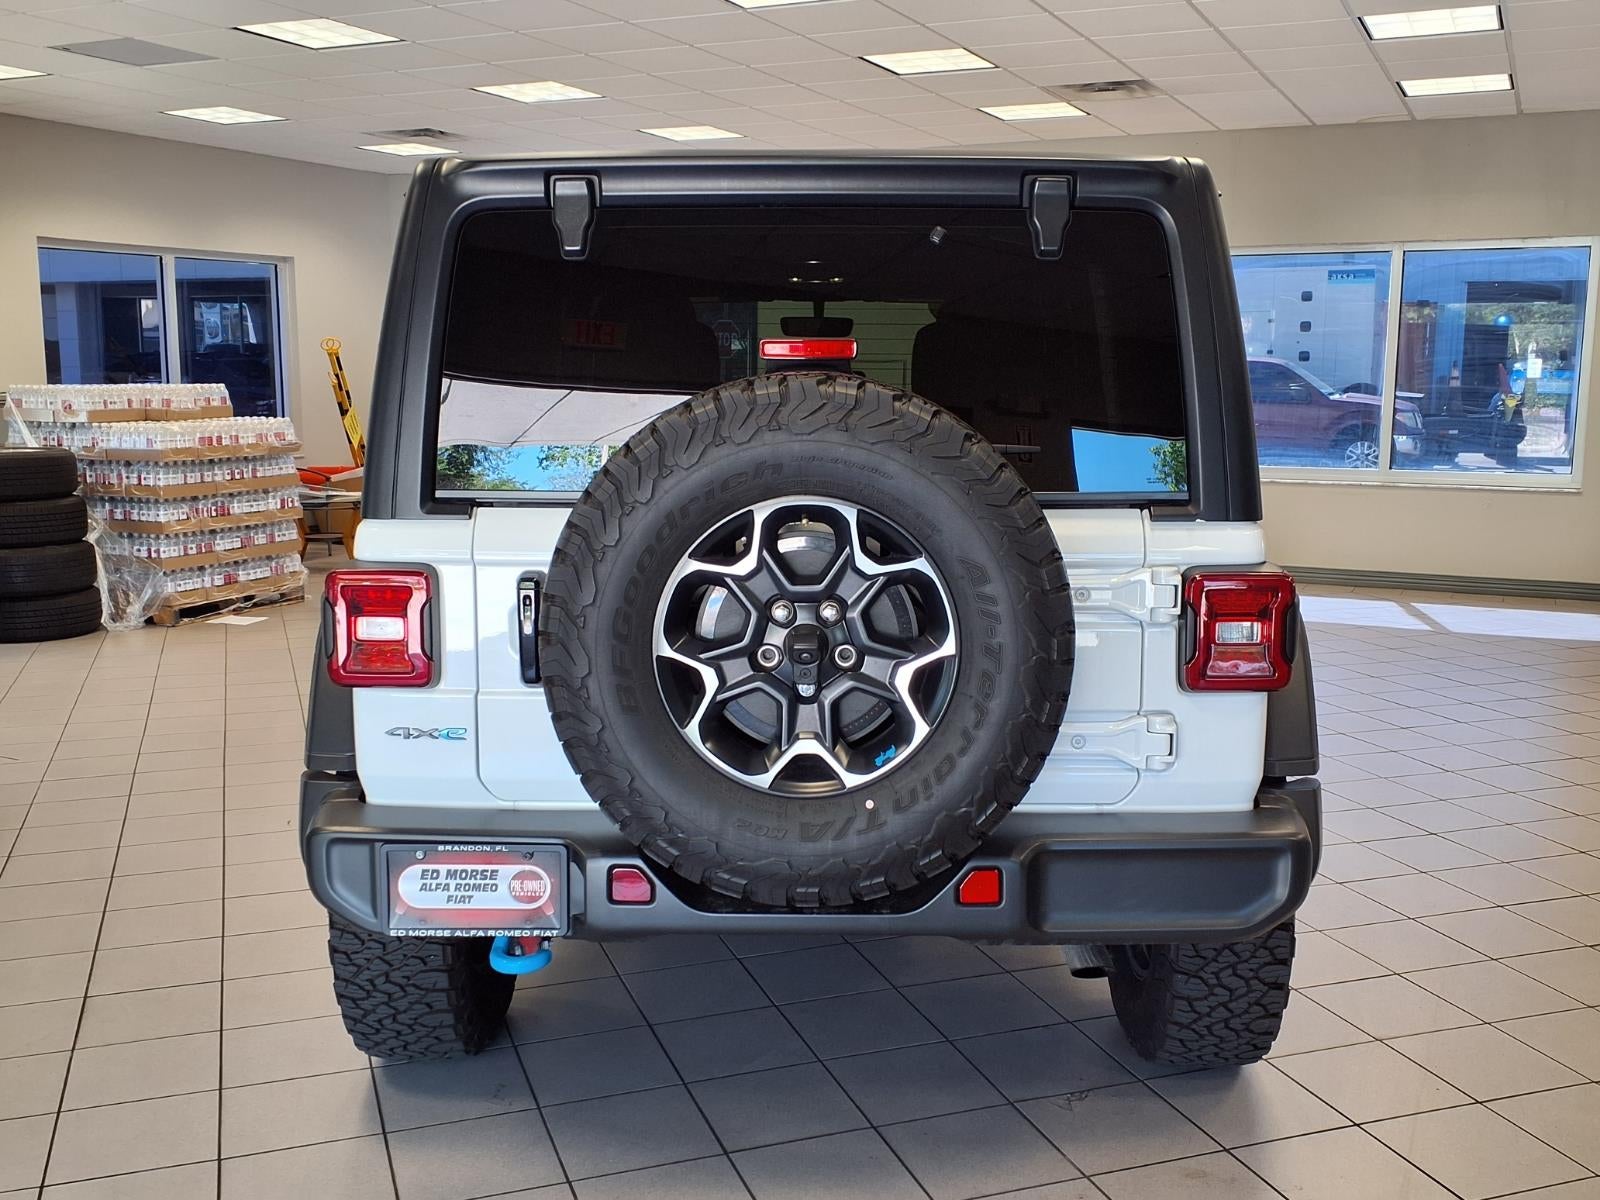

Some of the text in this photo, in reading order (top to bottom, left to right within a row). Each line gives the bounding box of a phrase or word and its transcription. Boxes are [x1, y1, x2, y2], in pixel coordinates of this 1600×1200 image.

[611, 459, 784, 716] BFGoodrich
[437, 844, 509, 853] BRANDON, FL
[420, 868, 499, 881] ED MORSE
[418, 882, 499, 893] ALFA ROMEO
[510, 879, 546, 892] PRE-OWNED
[446, 894, 474, 905] FIAT
[389, 929, 559, 937] ED MORSE ALFA ROMEO FIAT
